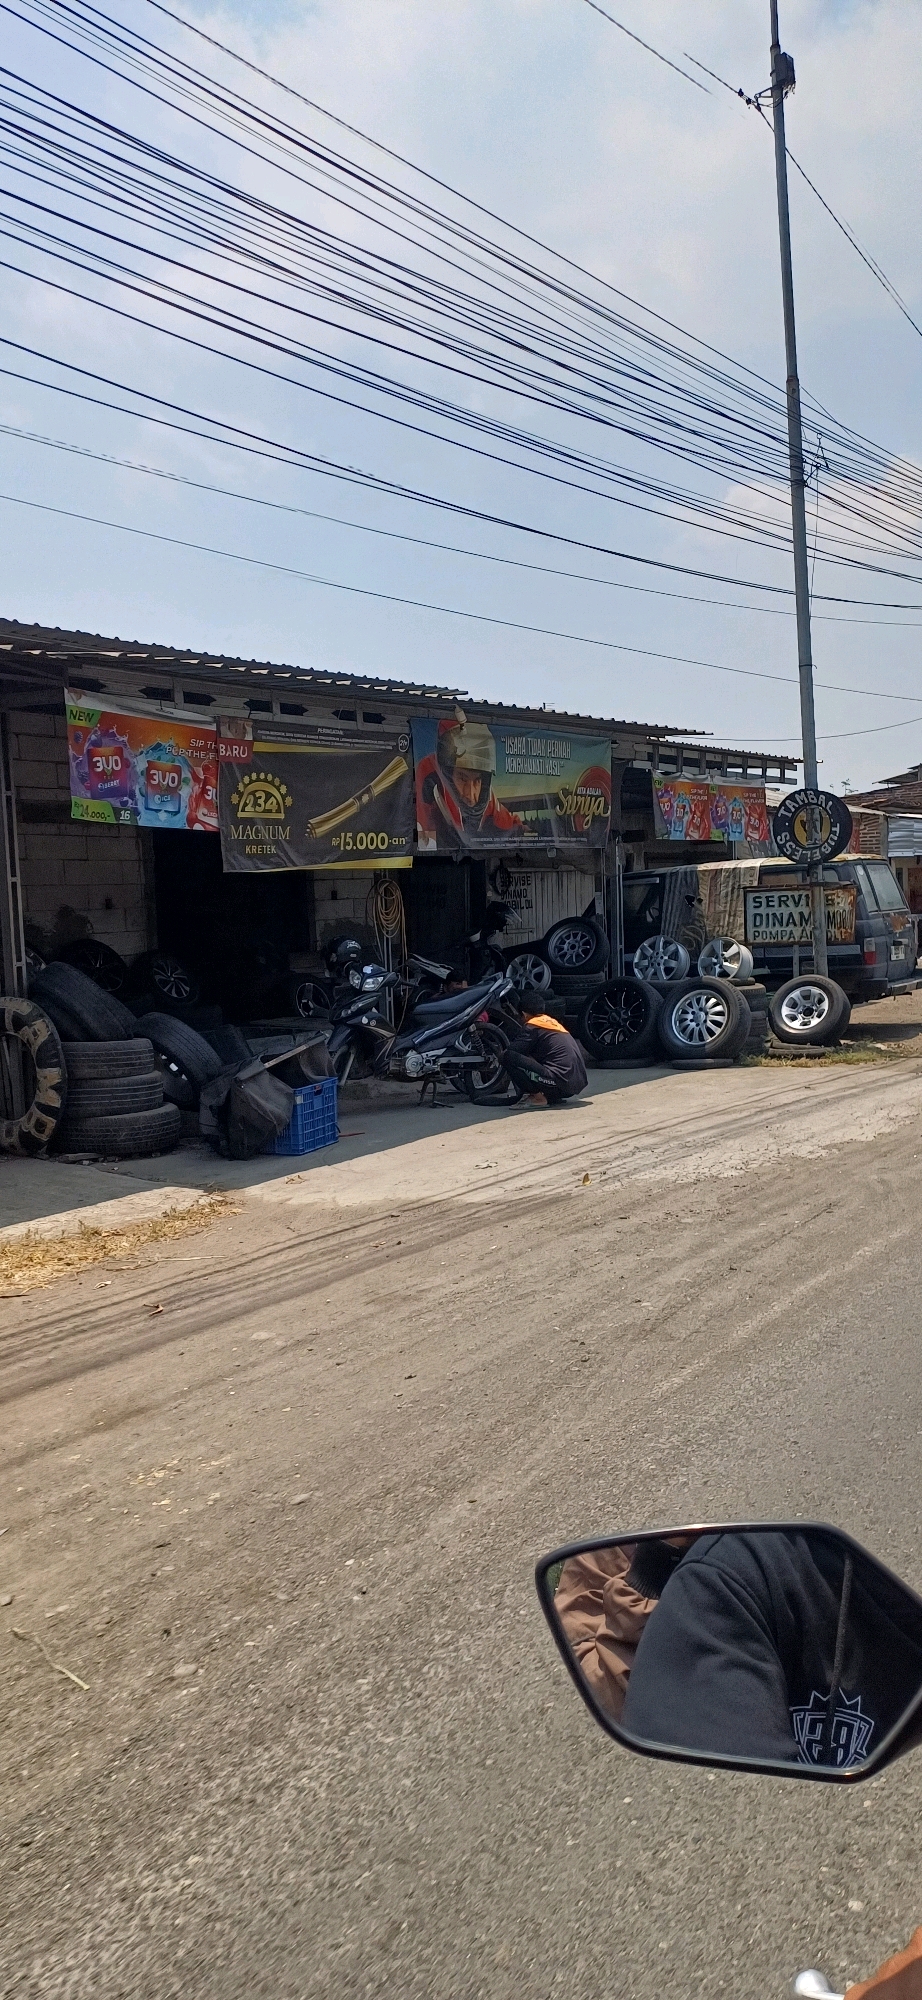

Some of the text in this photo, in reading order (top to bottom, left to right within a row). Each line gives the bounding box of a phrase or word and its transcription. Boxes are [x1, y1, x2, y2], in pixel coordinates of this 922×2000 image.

[69, 709, 95, 722] NEW
[190, 739, 205, 747] SIP
[527, 738, 546, 757] TIDAK
[547, 740, 571, 759] PERNAH
[166, 746, 185, 757] POP
[187, 749, 206, 759] THE
[219, 744, 248, 758] BARU
[244, 791, 278, 813] 234
[555, 785, 611, 830] Surya
[777, 790, 833, 818] TAMBAL
[120, 810, 131, 820] 16
[229, 825, 291, 840] MAGNUM
[245, 845, 277, 854] KRETEK
[776, 823, 840, 862] TUBELESS
[504, 899, 524, 909] OBIL
[752, 893, 836, 908] SERVIE
[753, 929, 796, 941] POMPA
